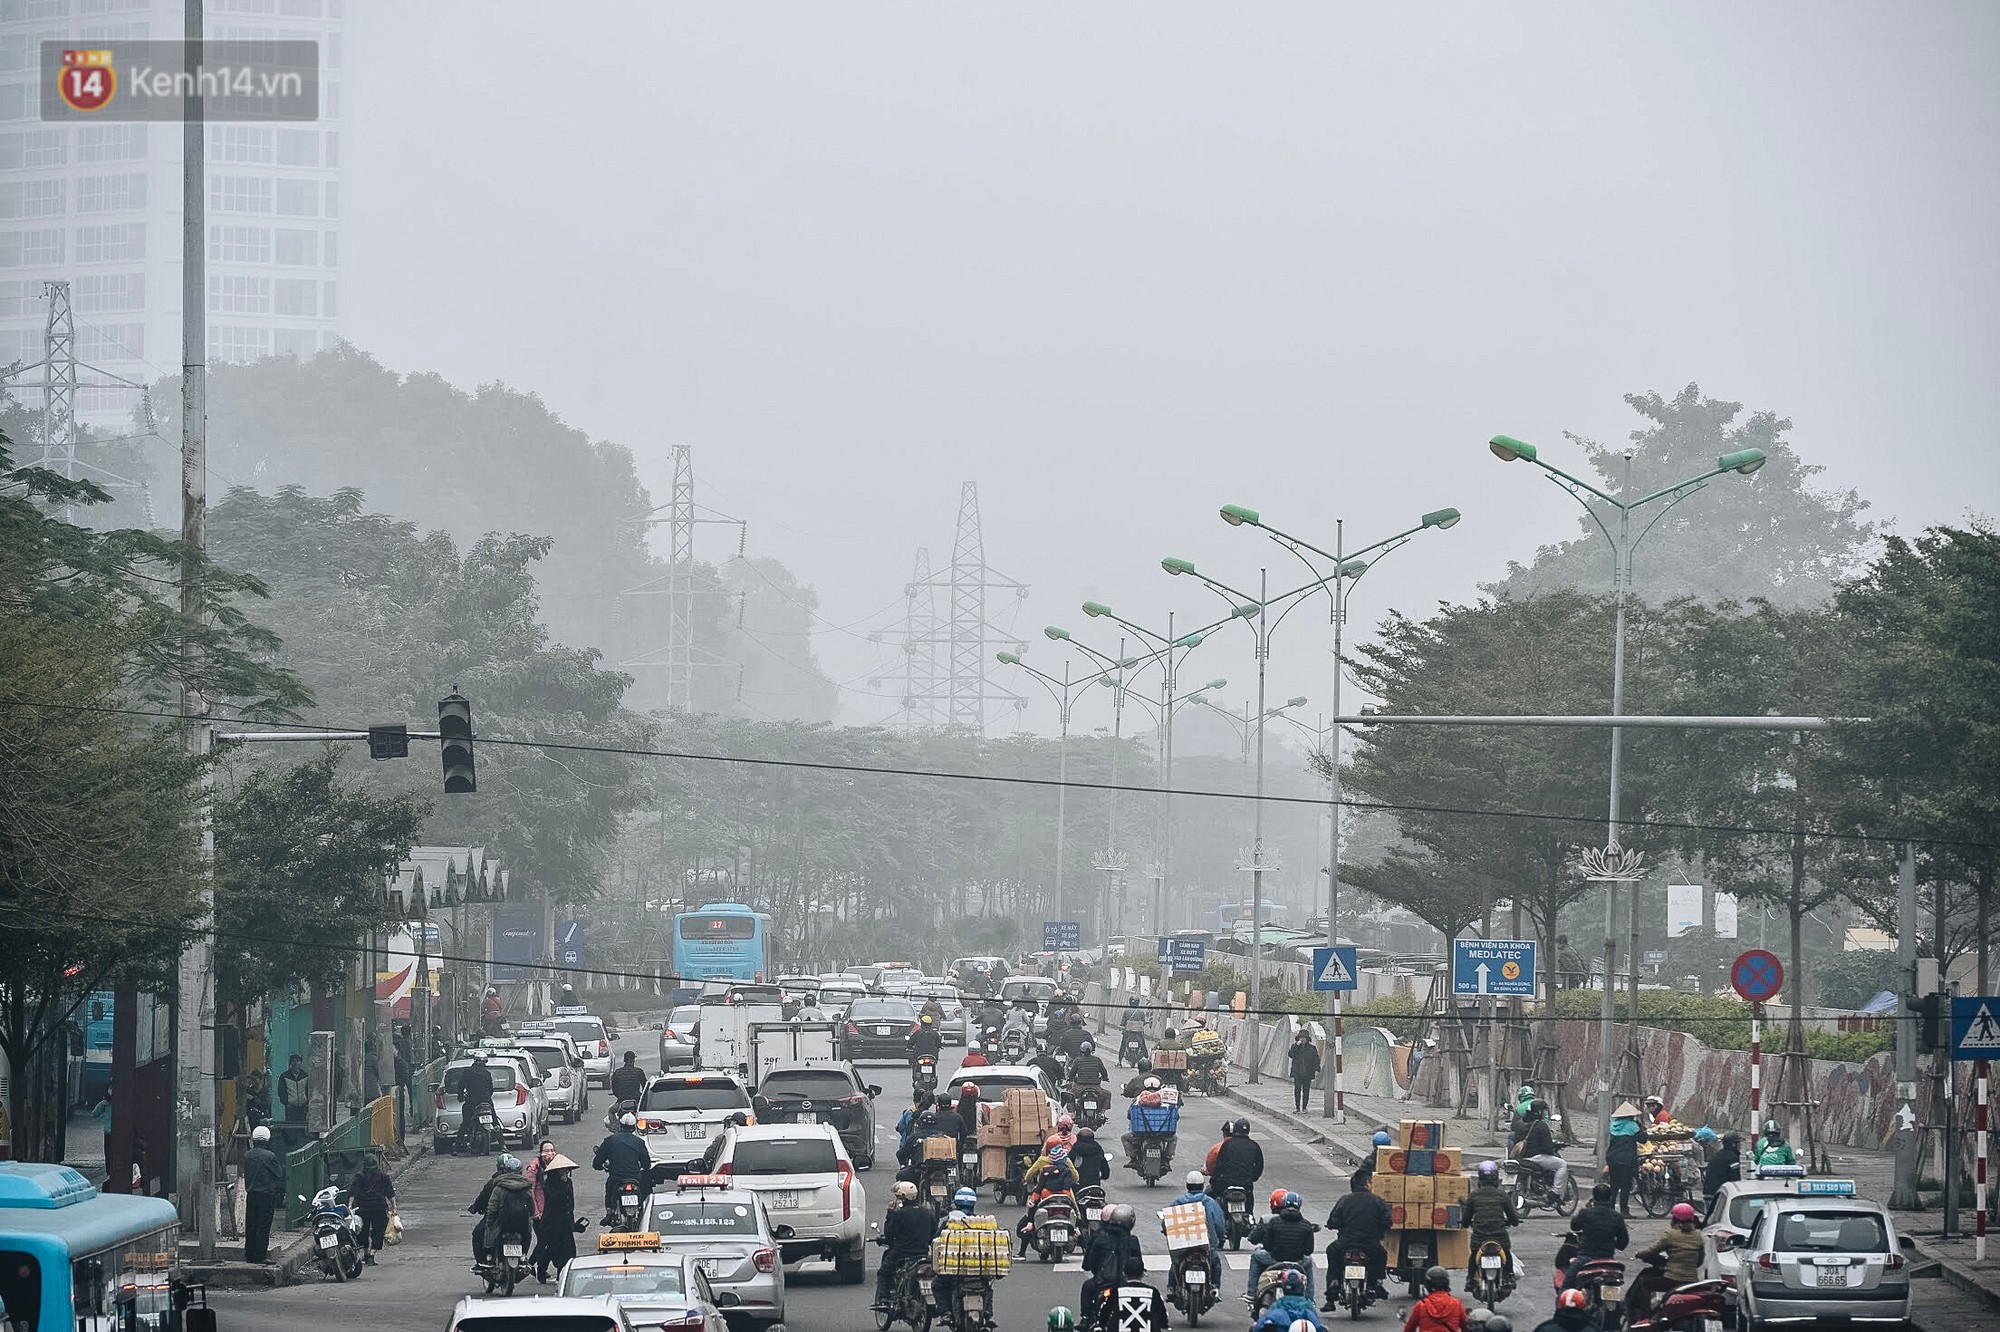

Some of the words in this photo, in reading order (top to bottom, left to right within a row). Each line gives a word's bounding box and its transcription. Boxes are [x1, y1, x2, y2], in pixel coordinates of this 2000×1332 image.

[1460, 940, 1480, 949] BỆNH
[1480, 941, 1498, 950] VIỆN
[1498, 942, 1510, 950] ĐA
[1468, 950, 1521, 960] MEDLATEC
[680, 1176, 700, 1184] Taxi
[704, 1176, 725, 1184] 123
[1824, 1266, 1840, 1275] 30A
